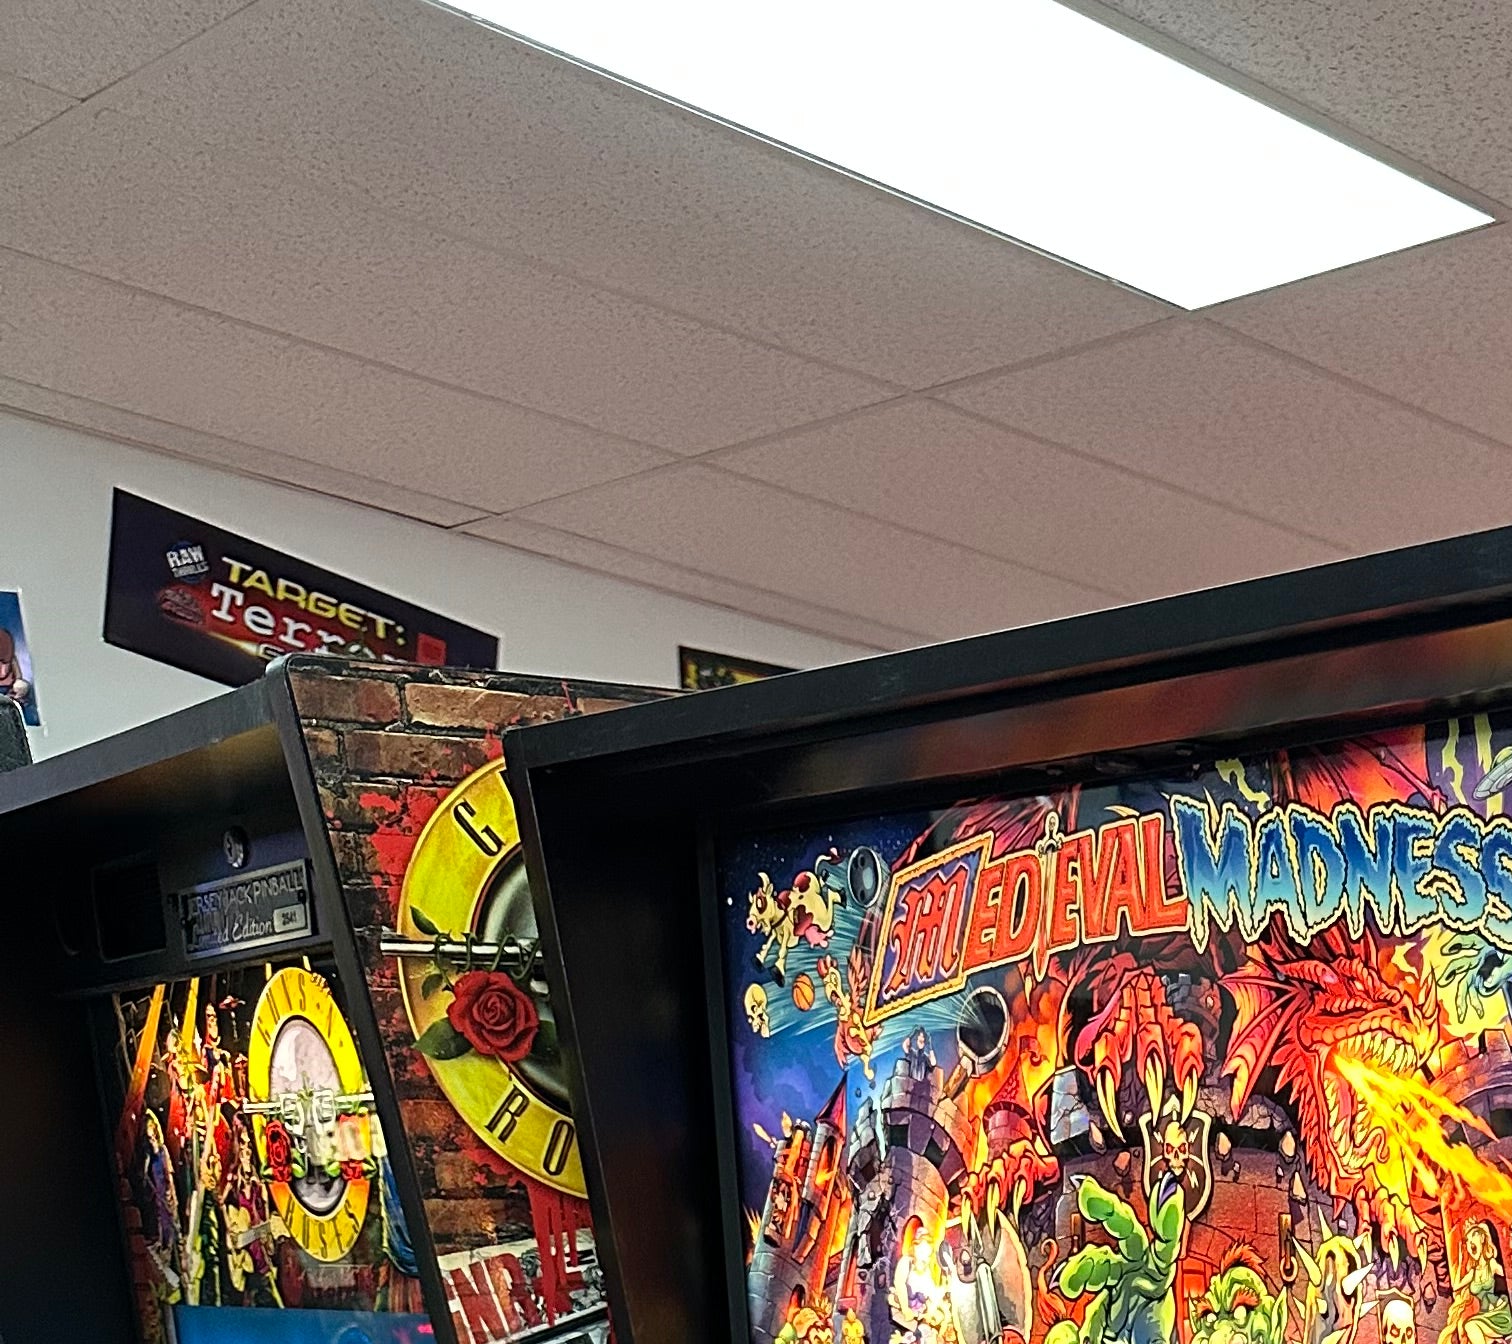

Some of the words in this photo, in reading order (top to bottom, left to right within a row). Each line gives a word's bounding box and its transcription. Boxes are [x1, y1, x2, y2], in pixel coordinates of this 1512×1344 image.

[166, 545, 204, 568] RAW
[209, 584, 408, 664] Terr
[220, 556, 406, 645] TARGET:
[253, 870, 303, 905] PINBALL
[868, 810, 1188, 1022] MEDIEVAL
